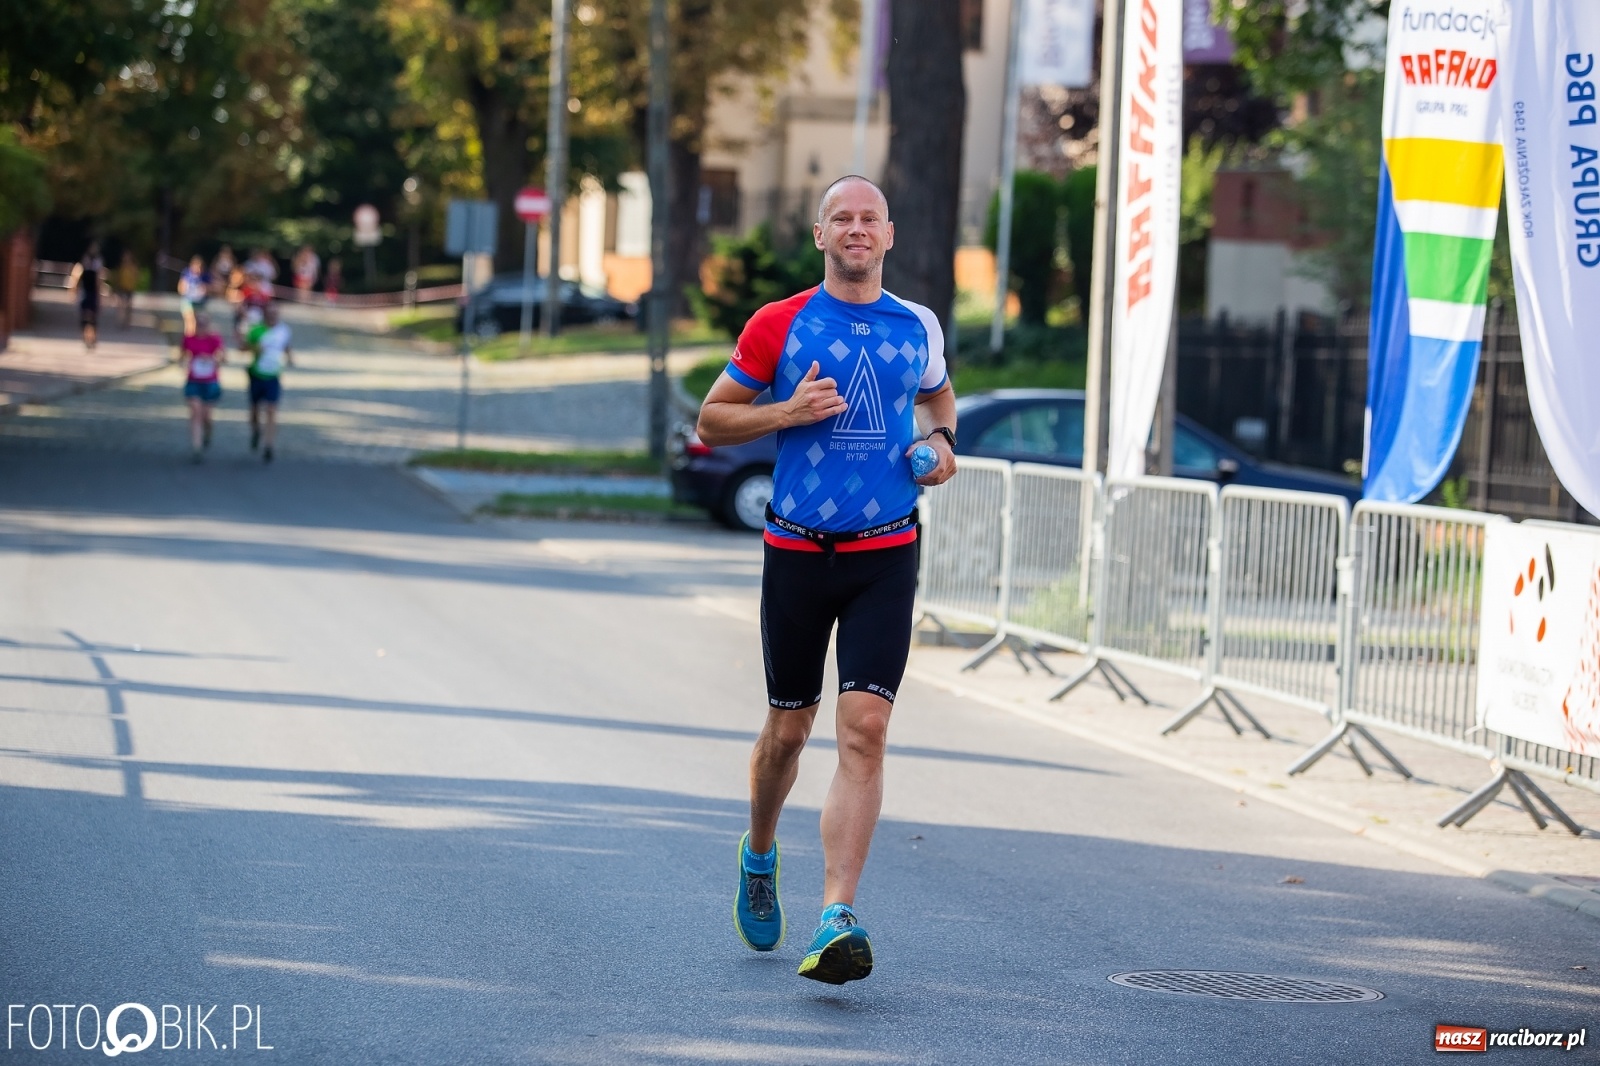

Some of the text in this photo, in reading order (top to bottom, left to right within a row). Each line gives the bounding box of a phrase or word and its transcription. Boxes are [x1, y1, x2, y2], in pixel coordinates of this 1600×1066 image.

[1400, 49, 1498, 90] RAFAKO
[829, 441, 886, 451] BIEG WIERCHAMI
[846, 452, 868, 461] RYTRO
[779, 700, 802, 708] cep
